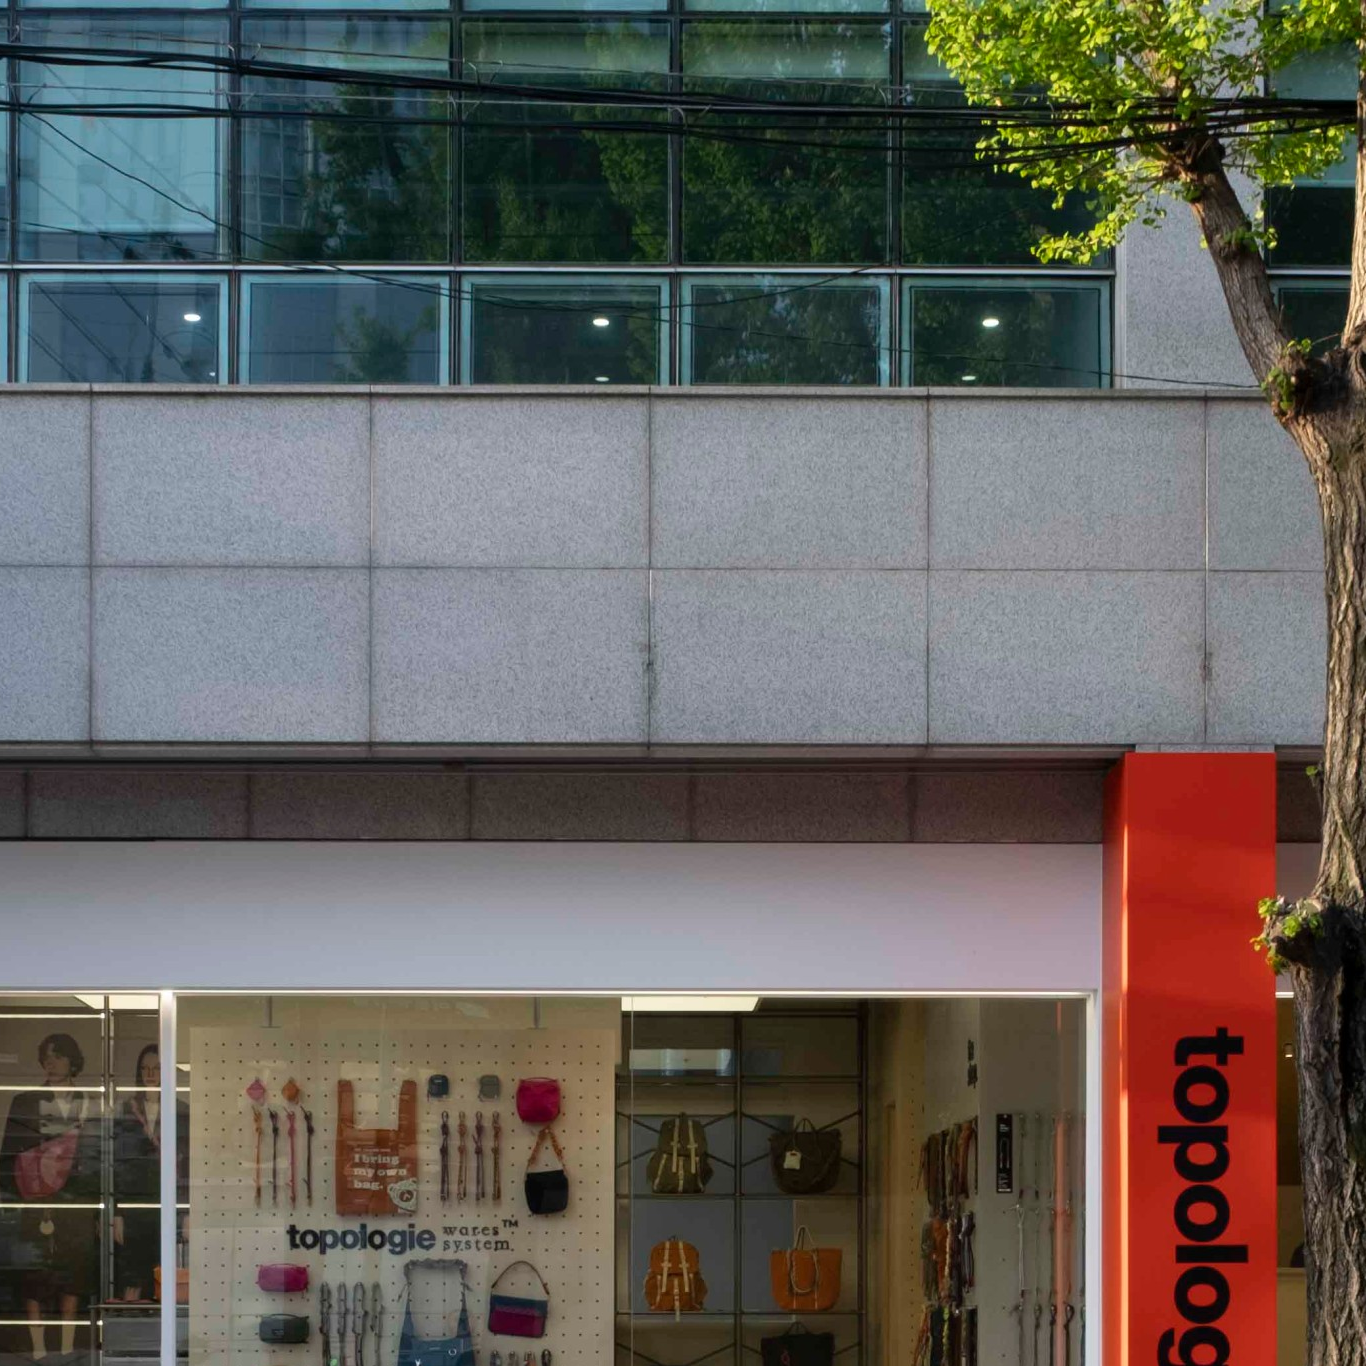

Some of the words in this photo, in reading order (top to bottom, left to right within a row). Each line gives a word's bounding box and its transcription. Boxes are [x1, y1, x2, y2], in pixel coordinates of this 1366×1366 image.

[362, 1154, 400, 1165] bring
[353, 1168, 375, 1178] my
[377, 1168, 407, 1177] own
[353, 1180, 384, 1191] bag.
[286, 1223, 437, 1255] topologie
